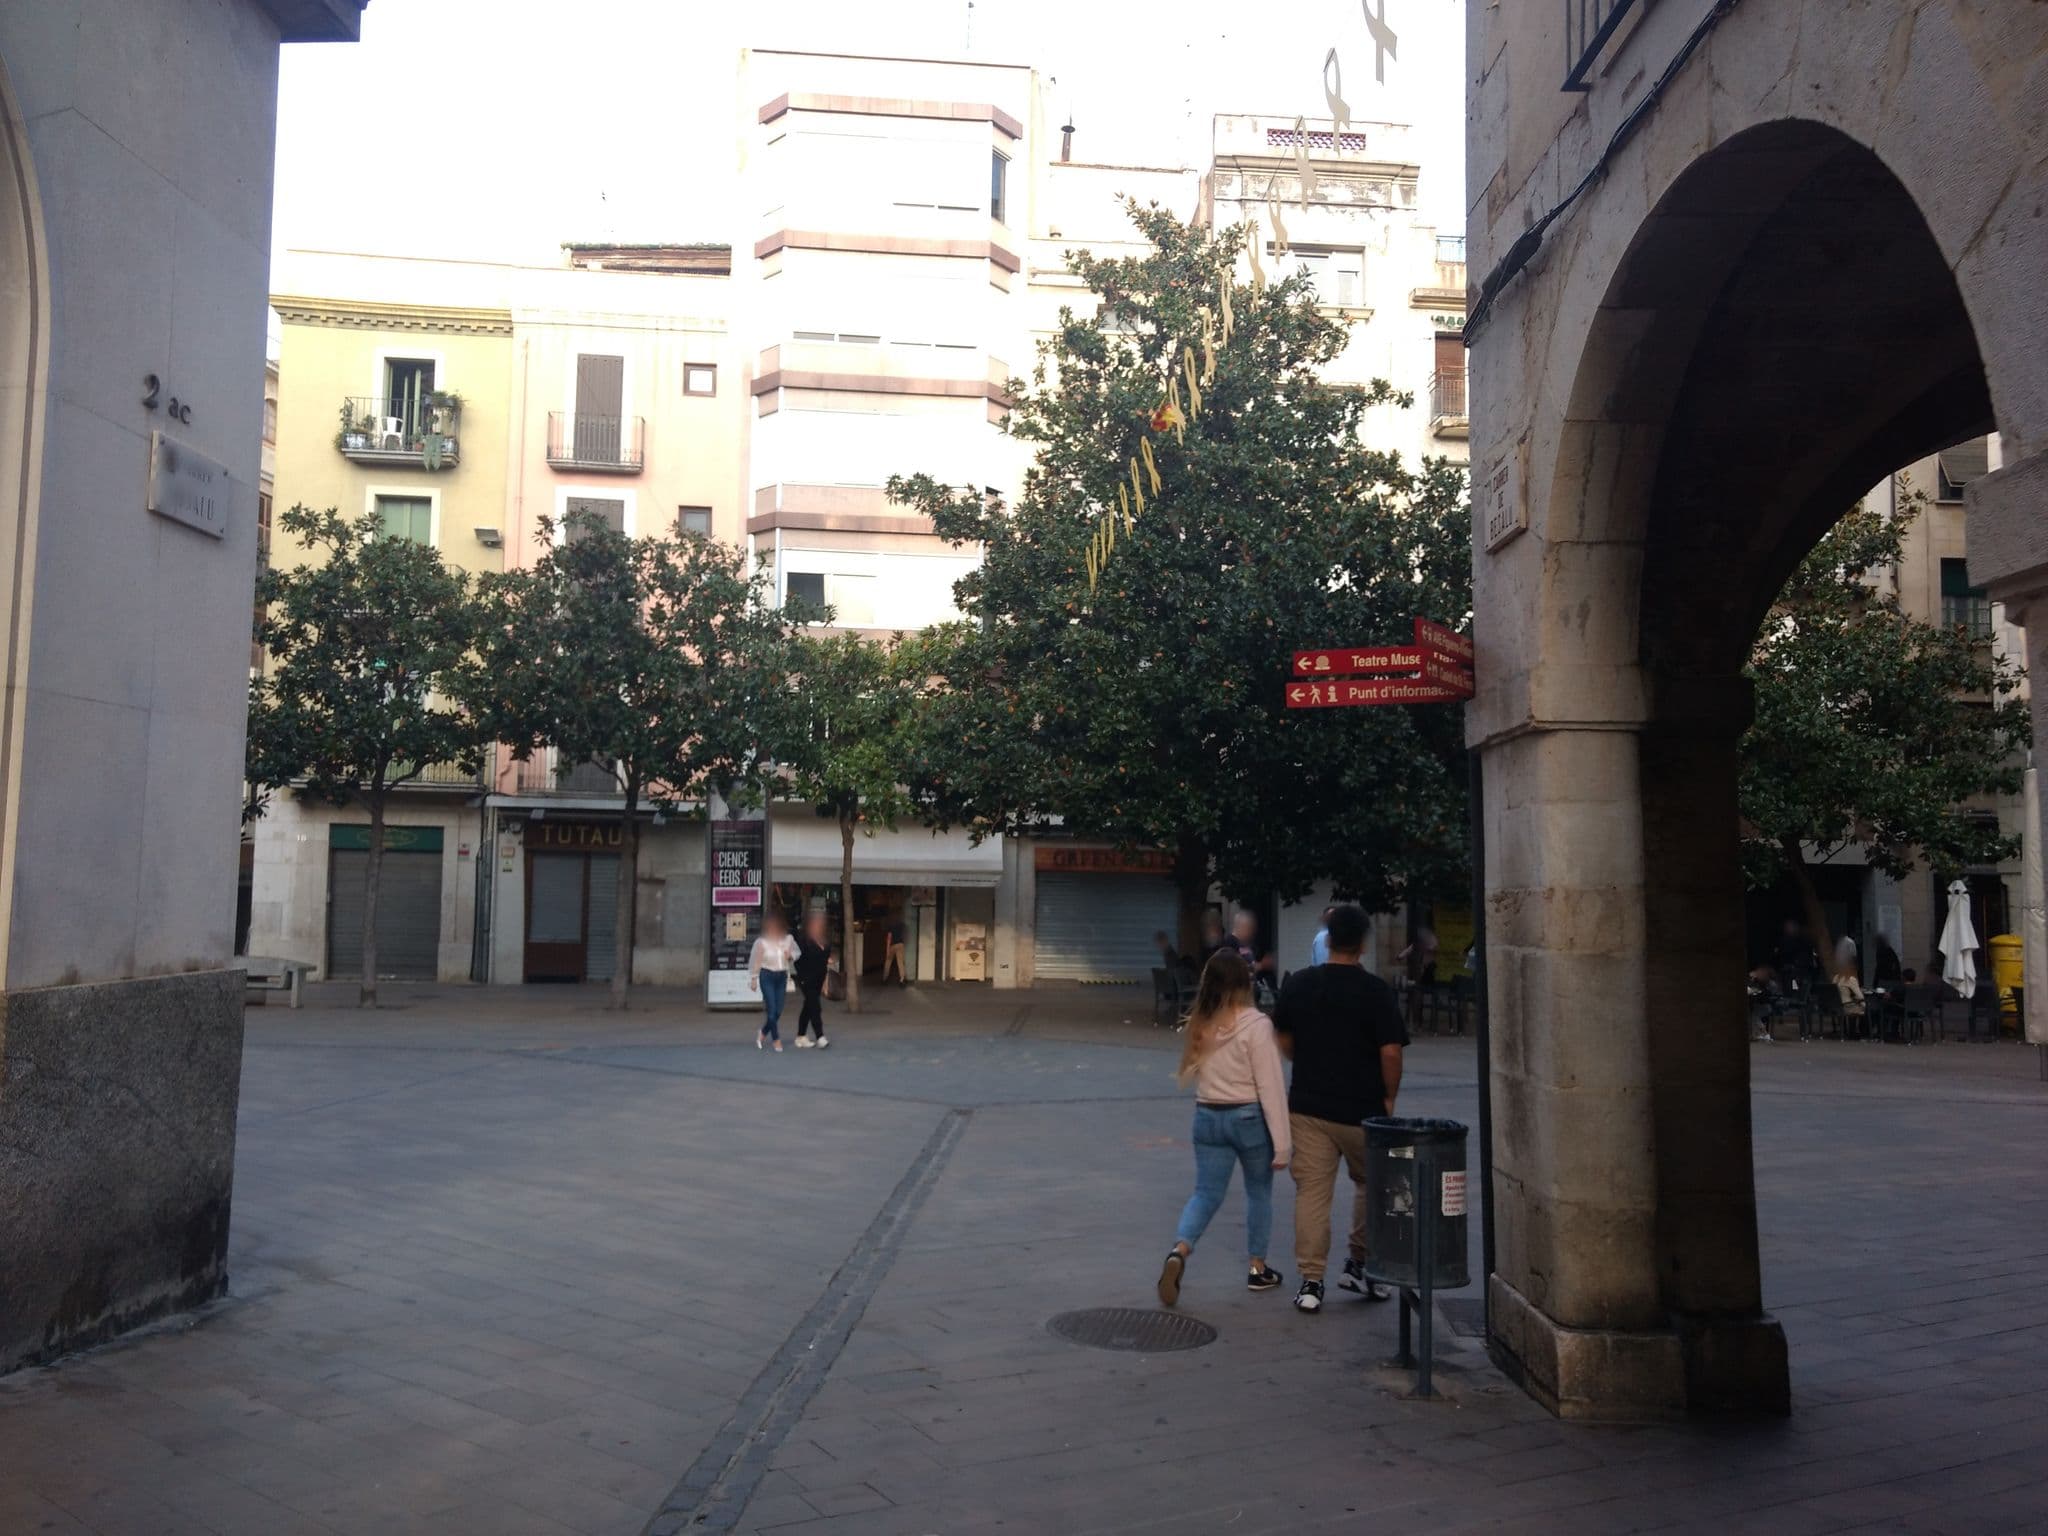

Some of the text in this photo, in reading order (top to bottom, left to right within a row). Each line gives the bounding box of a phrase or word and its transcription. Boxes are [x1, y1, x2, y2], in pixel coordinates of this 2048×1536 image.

[142, 374, 161, 410] 2
[1351, 655, 1388, 668] Teatre
[1391, 653, 1421, 666] Muse
[1349, 686, 1378, 699] Punt
[542, 823, 623, 846] TUTAU
[713, 851, 749, 868] SCIENCE
[713, 869, 762, 886] NEEDS YOU!
